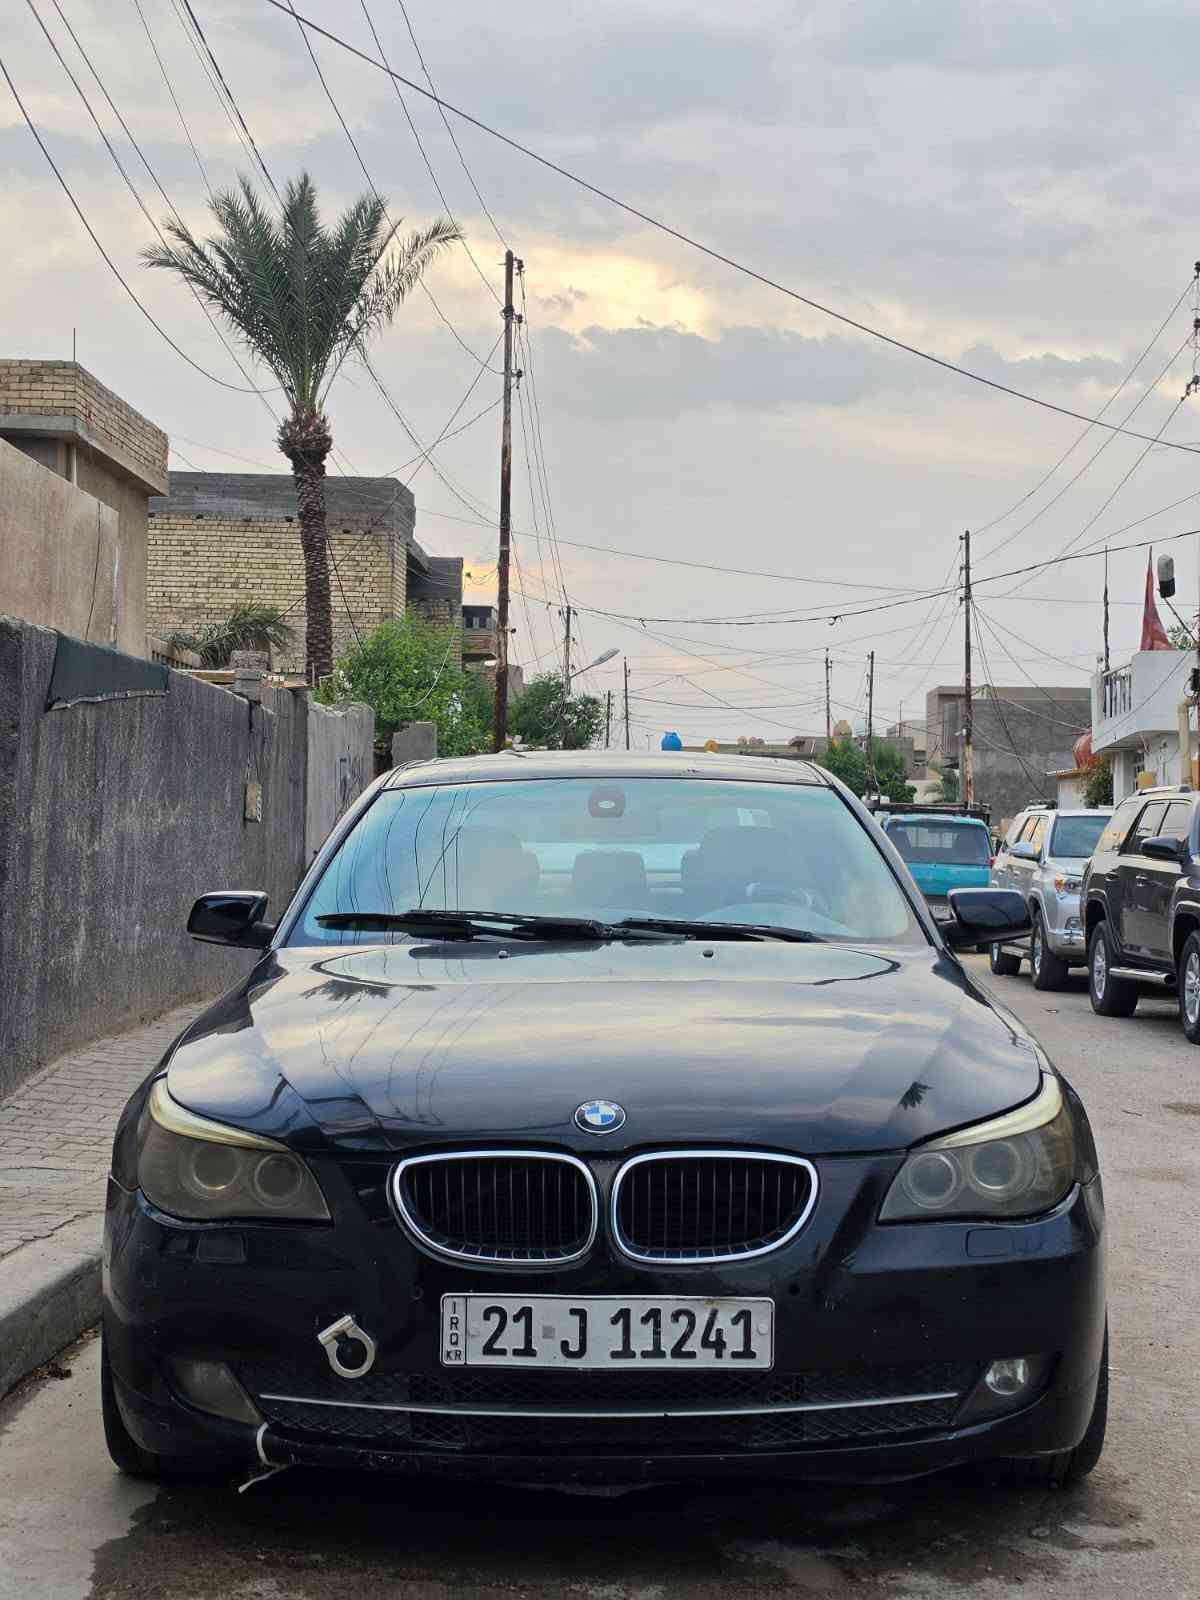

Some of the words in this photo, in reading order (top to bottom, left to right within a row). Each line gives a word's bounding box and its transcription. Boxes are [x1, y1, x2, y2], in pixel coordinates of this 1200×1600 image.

[482, 1305, 537, 1357] 21
[560, 1308, 588, 1359] J
[610, 1307, 757, 1360] 11241
[446, 1349, 463, 1361] KR
